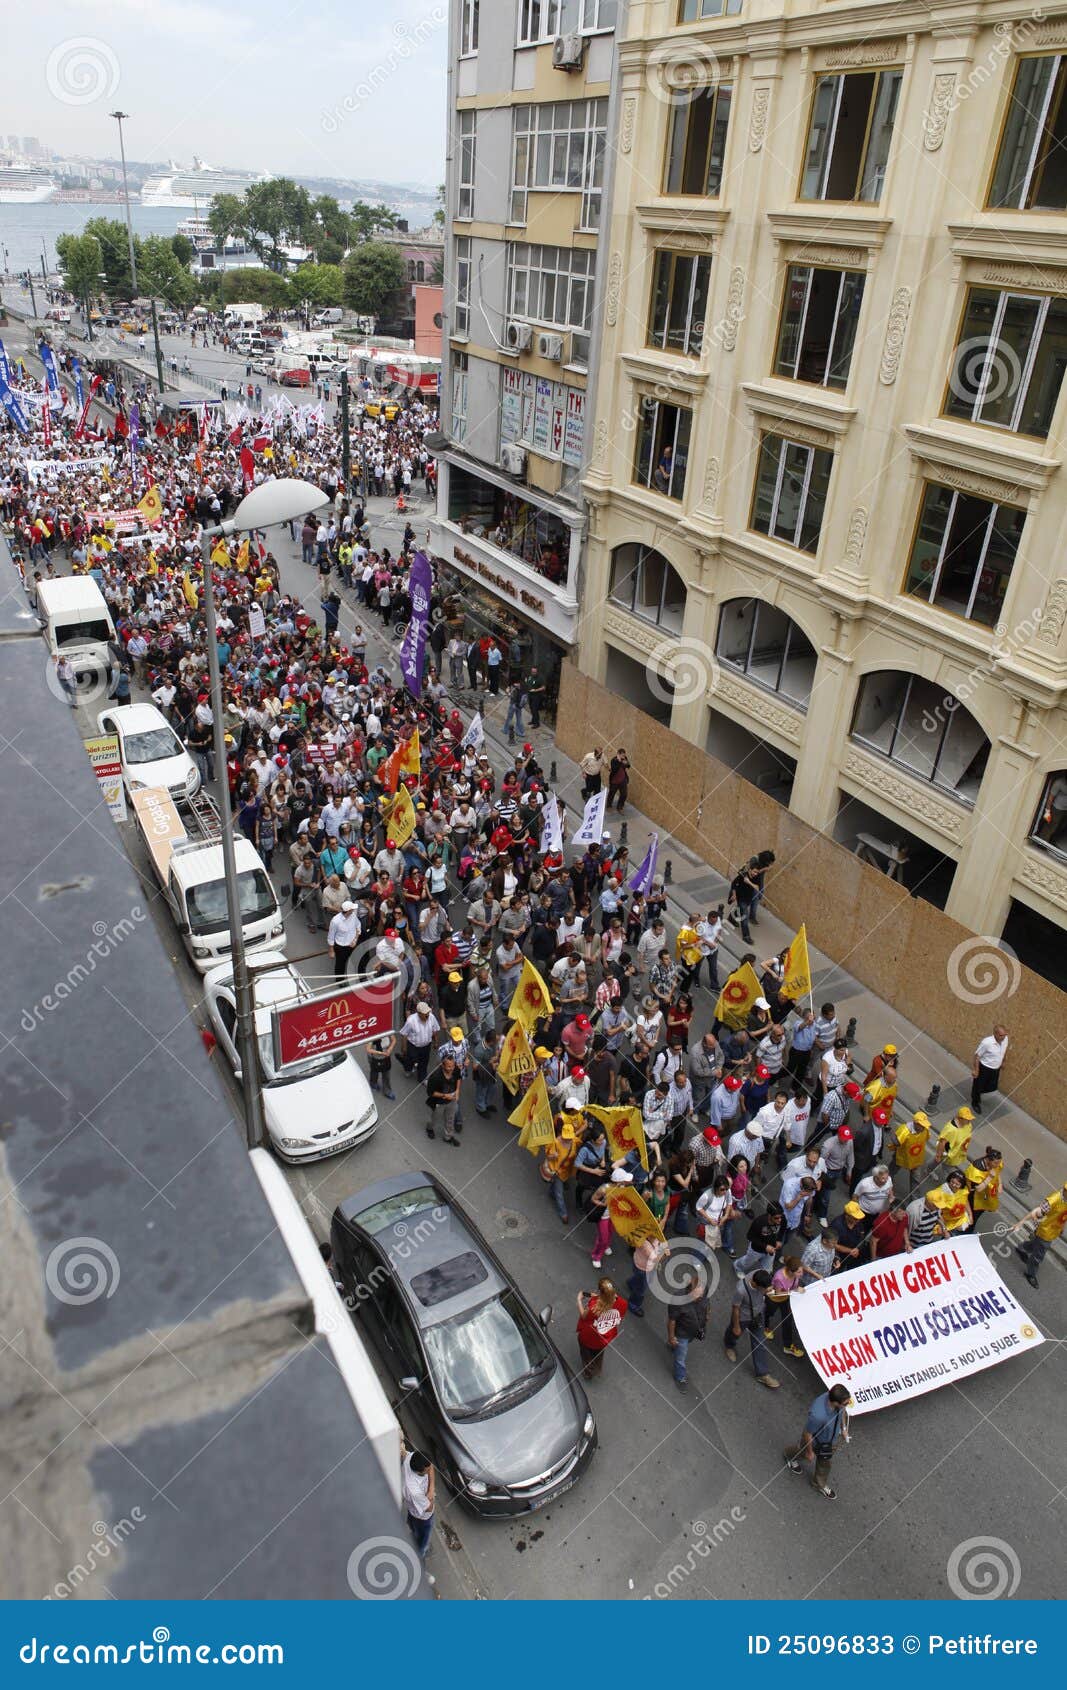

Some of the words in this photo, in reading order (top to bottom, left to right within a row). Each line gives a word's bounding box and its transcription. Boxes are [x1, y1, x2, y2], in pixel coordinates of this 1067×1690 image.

[504, 368, 522, 389] THY
[537, 386, 551, 396] KLM
[143, 793, 171, 835] Gigaset
[297, 1031, 329, 1048] 444
[333, 1024, 353, 1038] 62
[358, 1016, 377, 1030] 62
[822, 1270, 901, 1322] YAŞASIN
[902, 1253, 950, 1294] GREV
[950, 1250, 965, 1278] !
[812, 1333, 878, 1380] YAŞASIN
[873, 1316, 928, 1358] TOPLU
[924, 1288, 1007, 1341] SÖZLEŞME
[854, 1384, 883, 1404] EĞİTİM
[883, 1379, 901, 1395] SEN
[899, 1362, 951, 1389] İSTANBUL
[950, 1360, 959, 1371] 5
[989, 1332, 1021, 1355] ŞUBE
